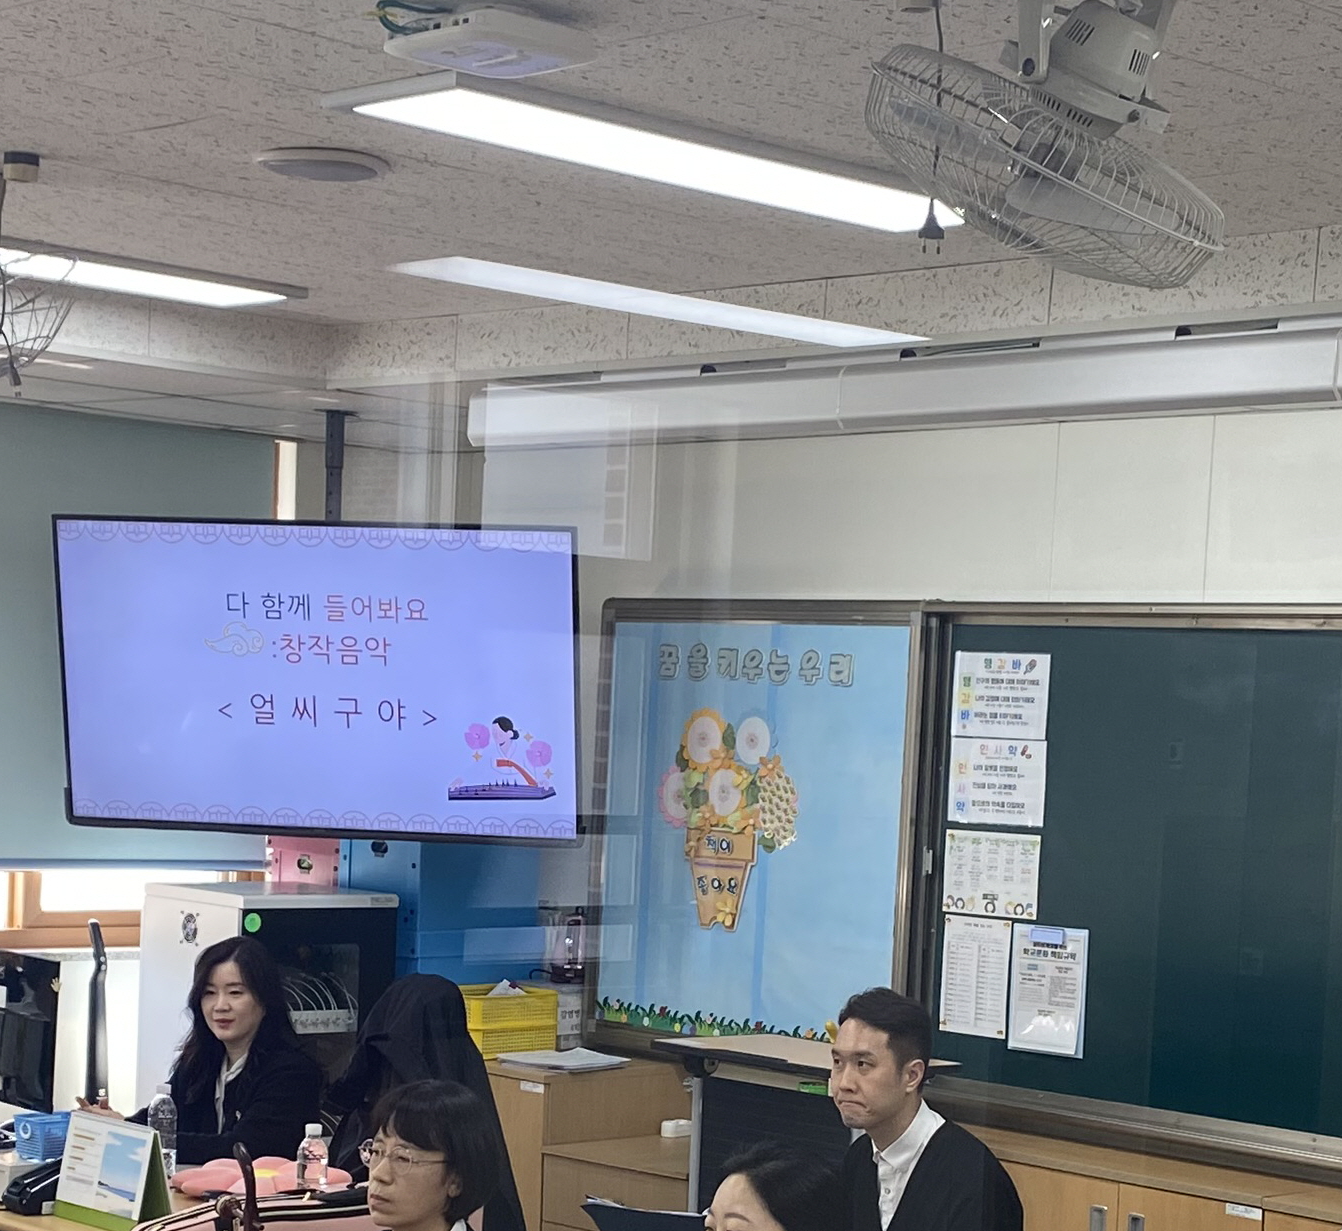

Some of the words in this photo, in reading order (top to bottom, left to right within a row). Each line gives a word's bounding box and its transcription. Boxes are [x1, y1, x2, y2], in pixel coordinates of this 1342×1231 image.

[225, 591, 250, 619] 다
[260, 592, 311, 621] 함께
[323, 594, 429, 624] 들어봐요
[717, 647, 791, 685] 키우는
[798, 649, 854, 687] 우리
[250, 693, 275, 725] 얼
[292, 695, 317, 727] 씨
[334, 698, 363, 728] 구
[378, 698, 407, 731] 야
